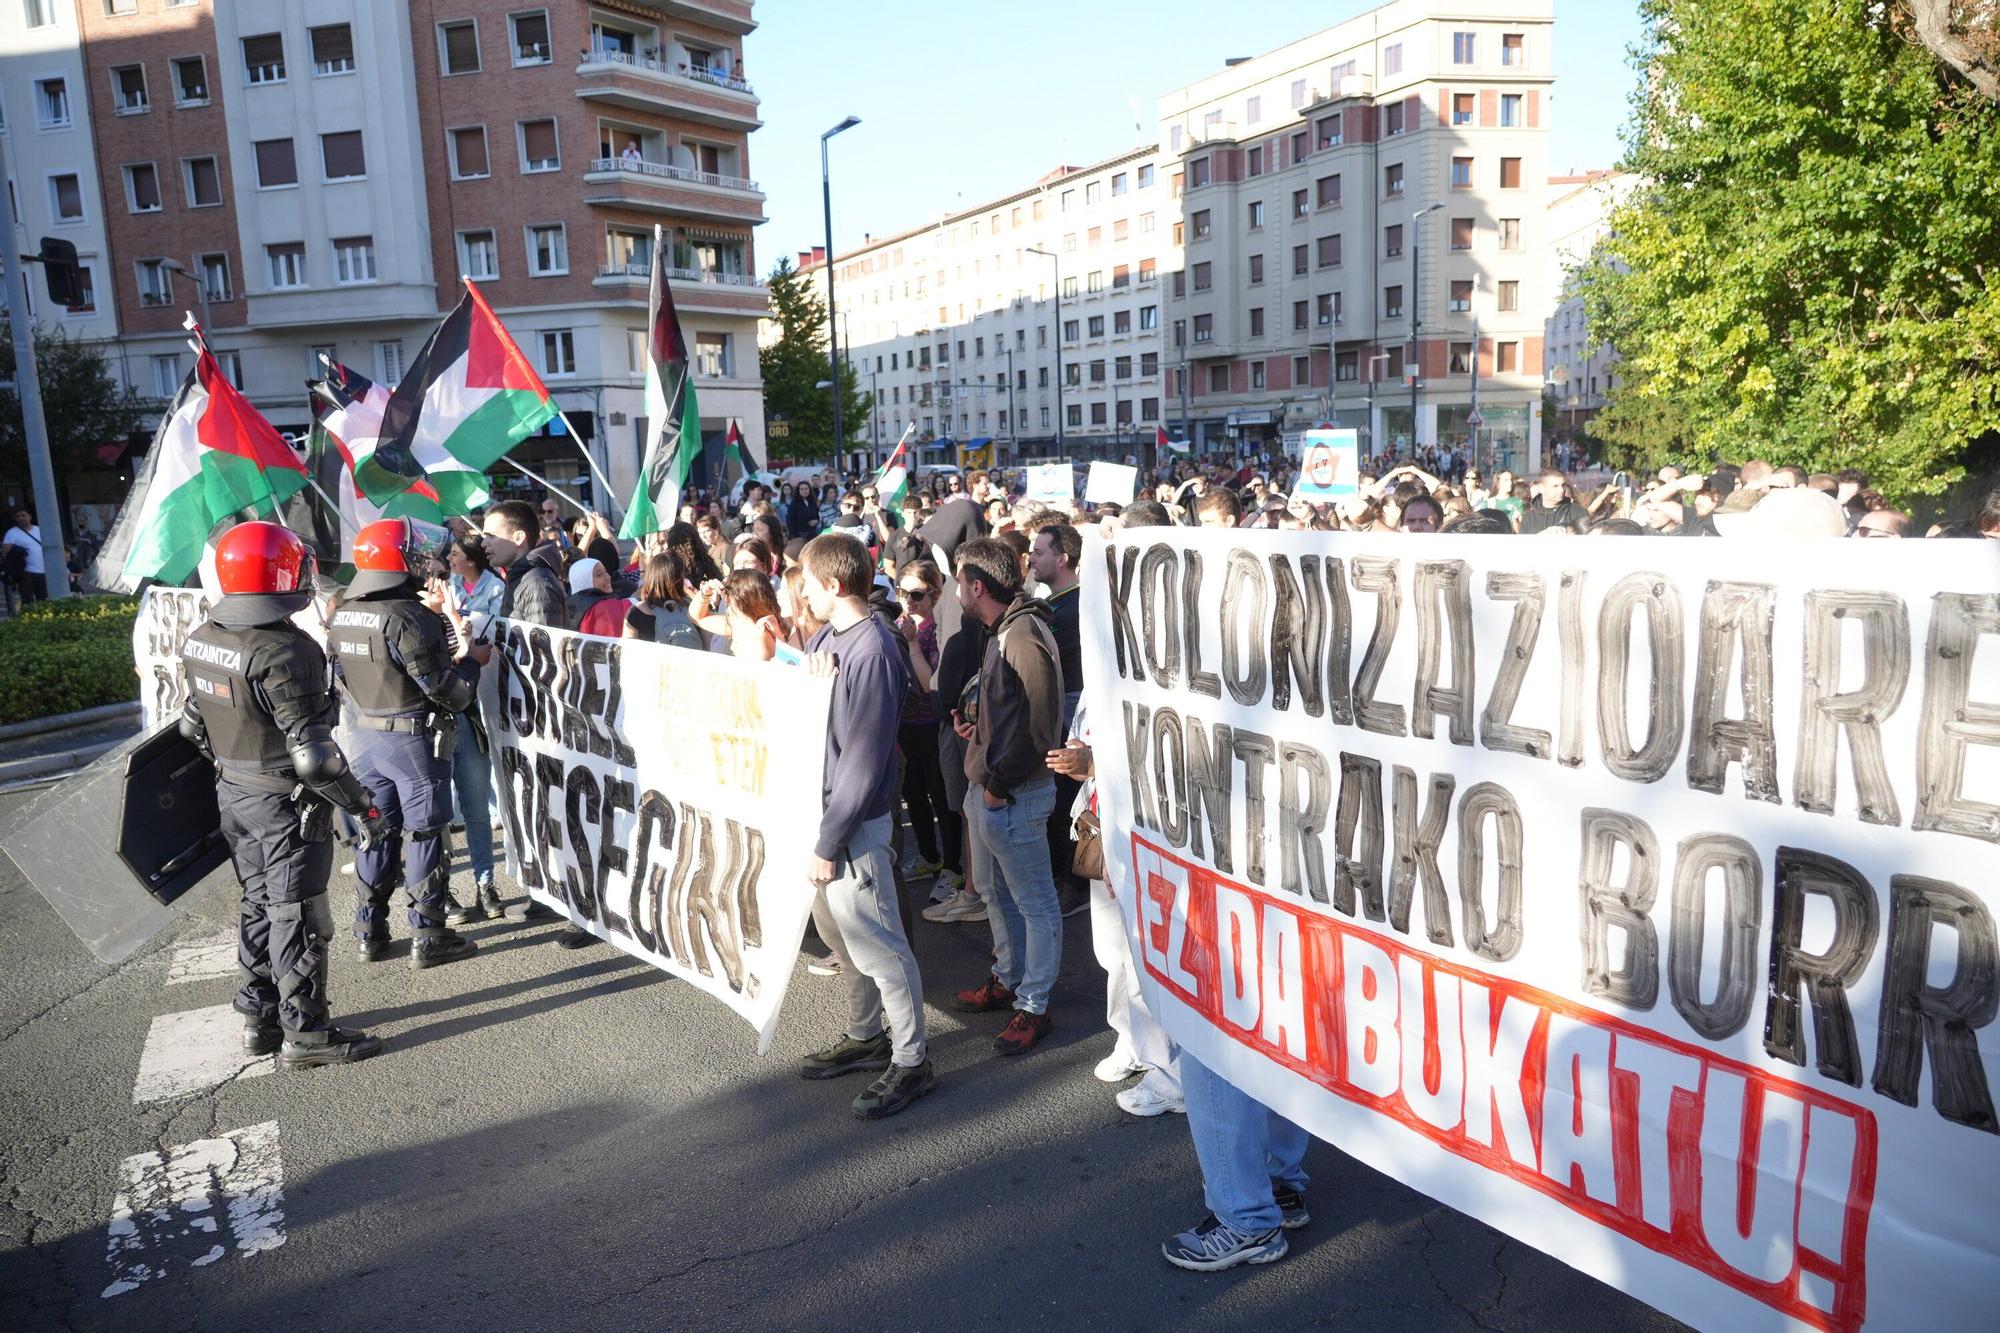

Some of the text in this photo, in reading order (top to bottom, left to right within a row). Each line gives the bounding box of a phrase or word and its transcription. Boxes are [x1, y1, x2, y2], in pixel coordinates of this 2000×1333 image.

[768, 426, 789, 437] ORO
[495, 620, 638, 769] ISRAEL
[1105, 542, 2000, 845] KOLONIZAZIOARE
[1122, 700, 1524, 962] KONTRAKO
[1136, 842, 1857, 1315] EZ DA BUKATU!
[1580, 807, 2000, 1134] BORR
